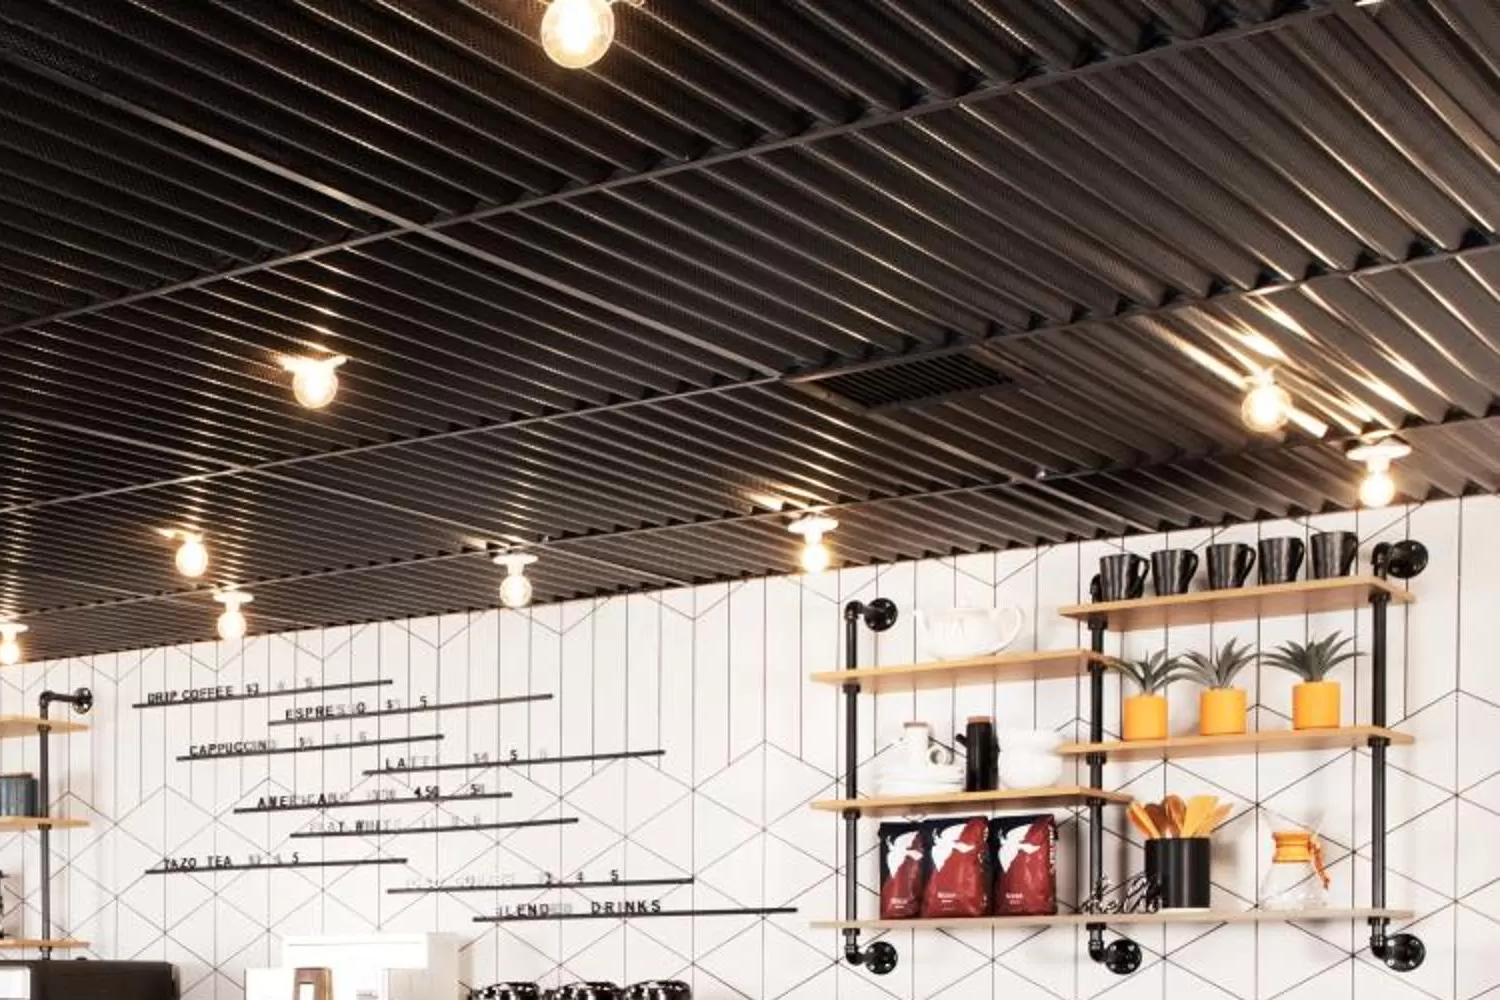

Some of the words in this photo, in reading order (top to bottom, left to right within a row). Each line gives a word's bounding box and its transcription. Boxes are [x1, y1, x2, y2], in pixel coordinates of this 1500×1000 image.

[182, 685, 233, 701] COFFEE
[164, 858, 197, 871] TAZO
[206, 855, 232, 868] TEA
[610, 869, 620, 883] 5
[495, 903, 573, 919] LEND
[590, 900, 661, 915] DRINKS
